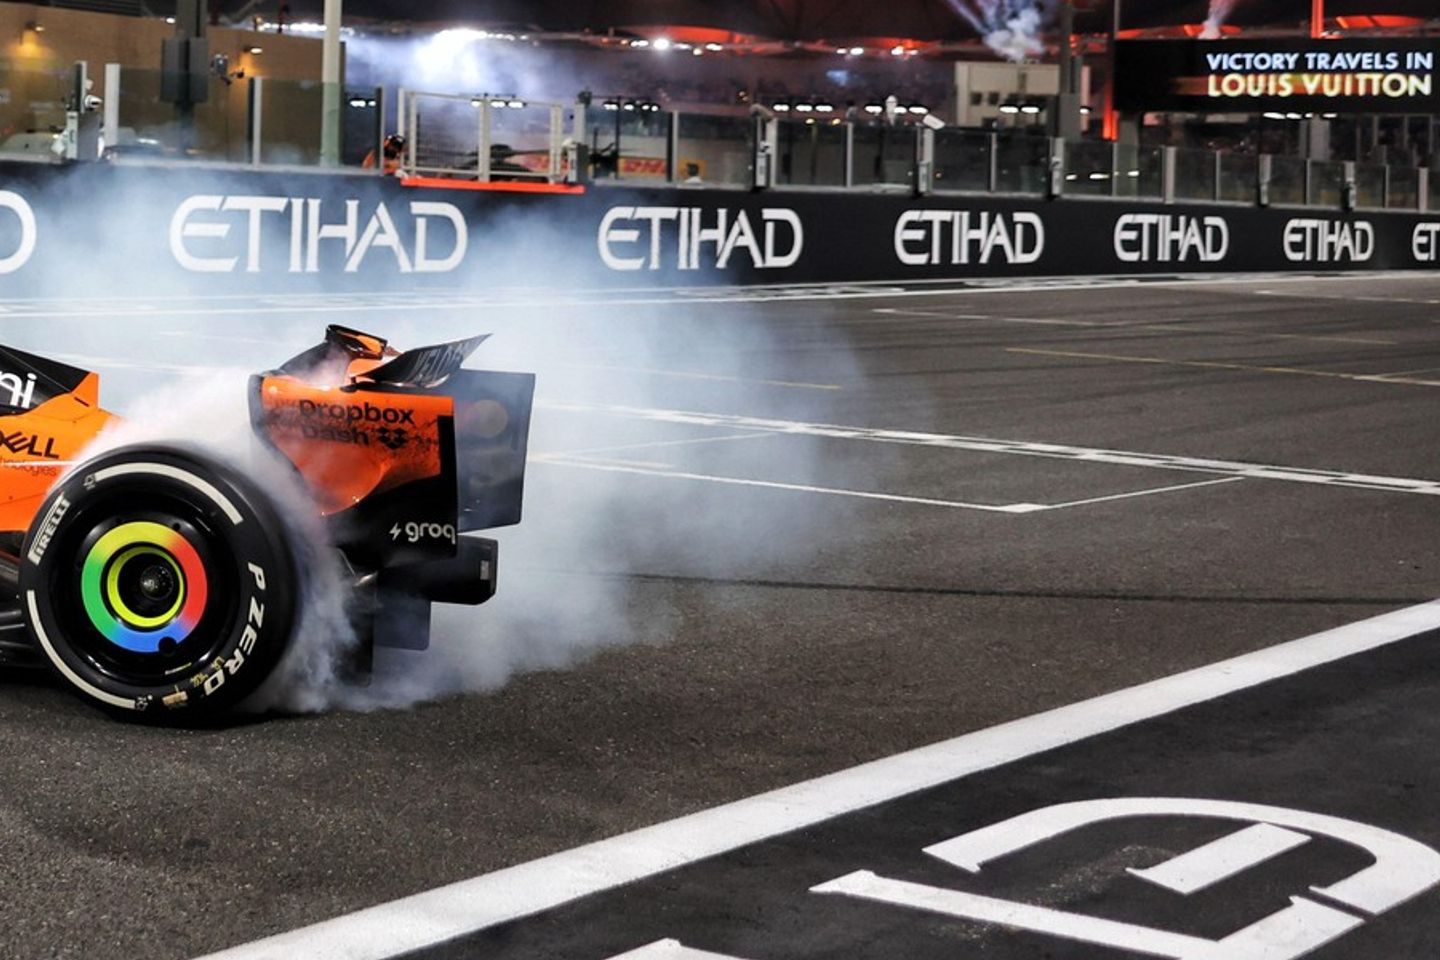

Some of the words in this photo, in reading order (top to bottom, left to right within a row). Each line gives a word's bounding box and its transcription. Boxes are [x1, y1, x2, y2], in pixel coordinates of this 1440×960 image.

[1206, 52, 1300, 70] VICTORY
[1304, 51, 1399, 70] TRAVELS
[1406, 52, 1433, 70] IN
[1207, 73, 1294, 97] LOUIS
[1301, 73, 1432, 97] VUITTON
[168, 194, 469, 274] ETIHAD
[597, 205, 804, 271] ETIHAD
[893, 209, 1045, 266] ETIHAD
[1113, 213, 1230, 263] ETIHAD
[1283, 218, 1375, 261] ETIHAD
[299, 399, 415, 425] Dropbox
[302, 424, 370, 448] Dash
[404, 521, 456, 544] groq
[247, 561, 266, 590] P
[203, 595, 266, 696] ZERO
